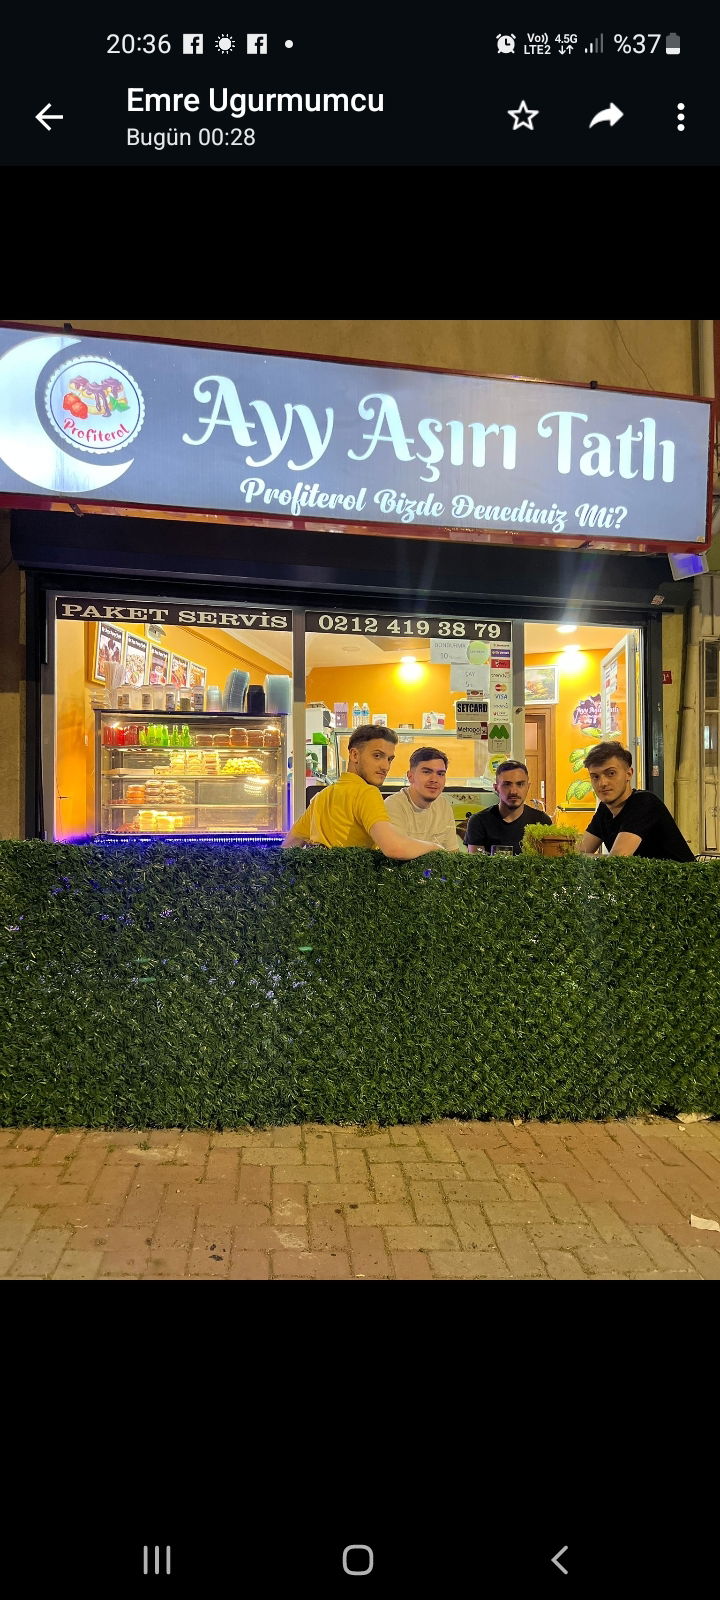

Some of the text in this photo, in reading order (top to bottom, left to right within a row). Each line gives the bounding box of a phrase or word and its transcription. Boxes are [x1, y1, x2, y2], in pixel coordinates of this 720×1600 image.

[63, 418, 130, 442] Profiterol
[182, 375, 676, 483] Ayy Aşırı Tatlı
[239, 477, 628, 533] Profiterol Bizde Denediniz Mi?
[61, 603, 288, 629] PAKET SERVİS
[318, 614, 501, 639] 0212 419 38 79
[457, 703, 488, 713] SETCARD
